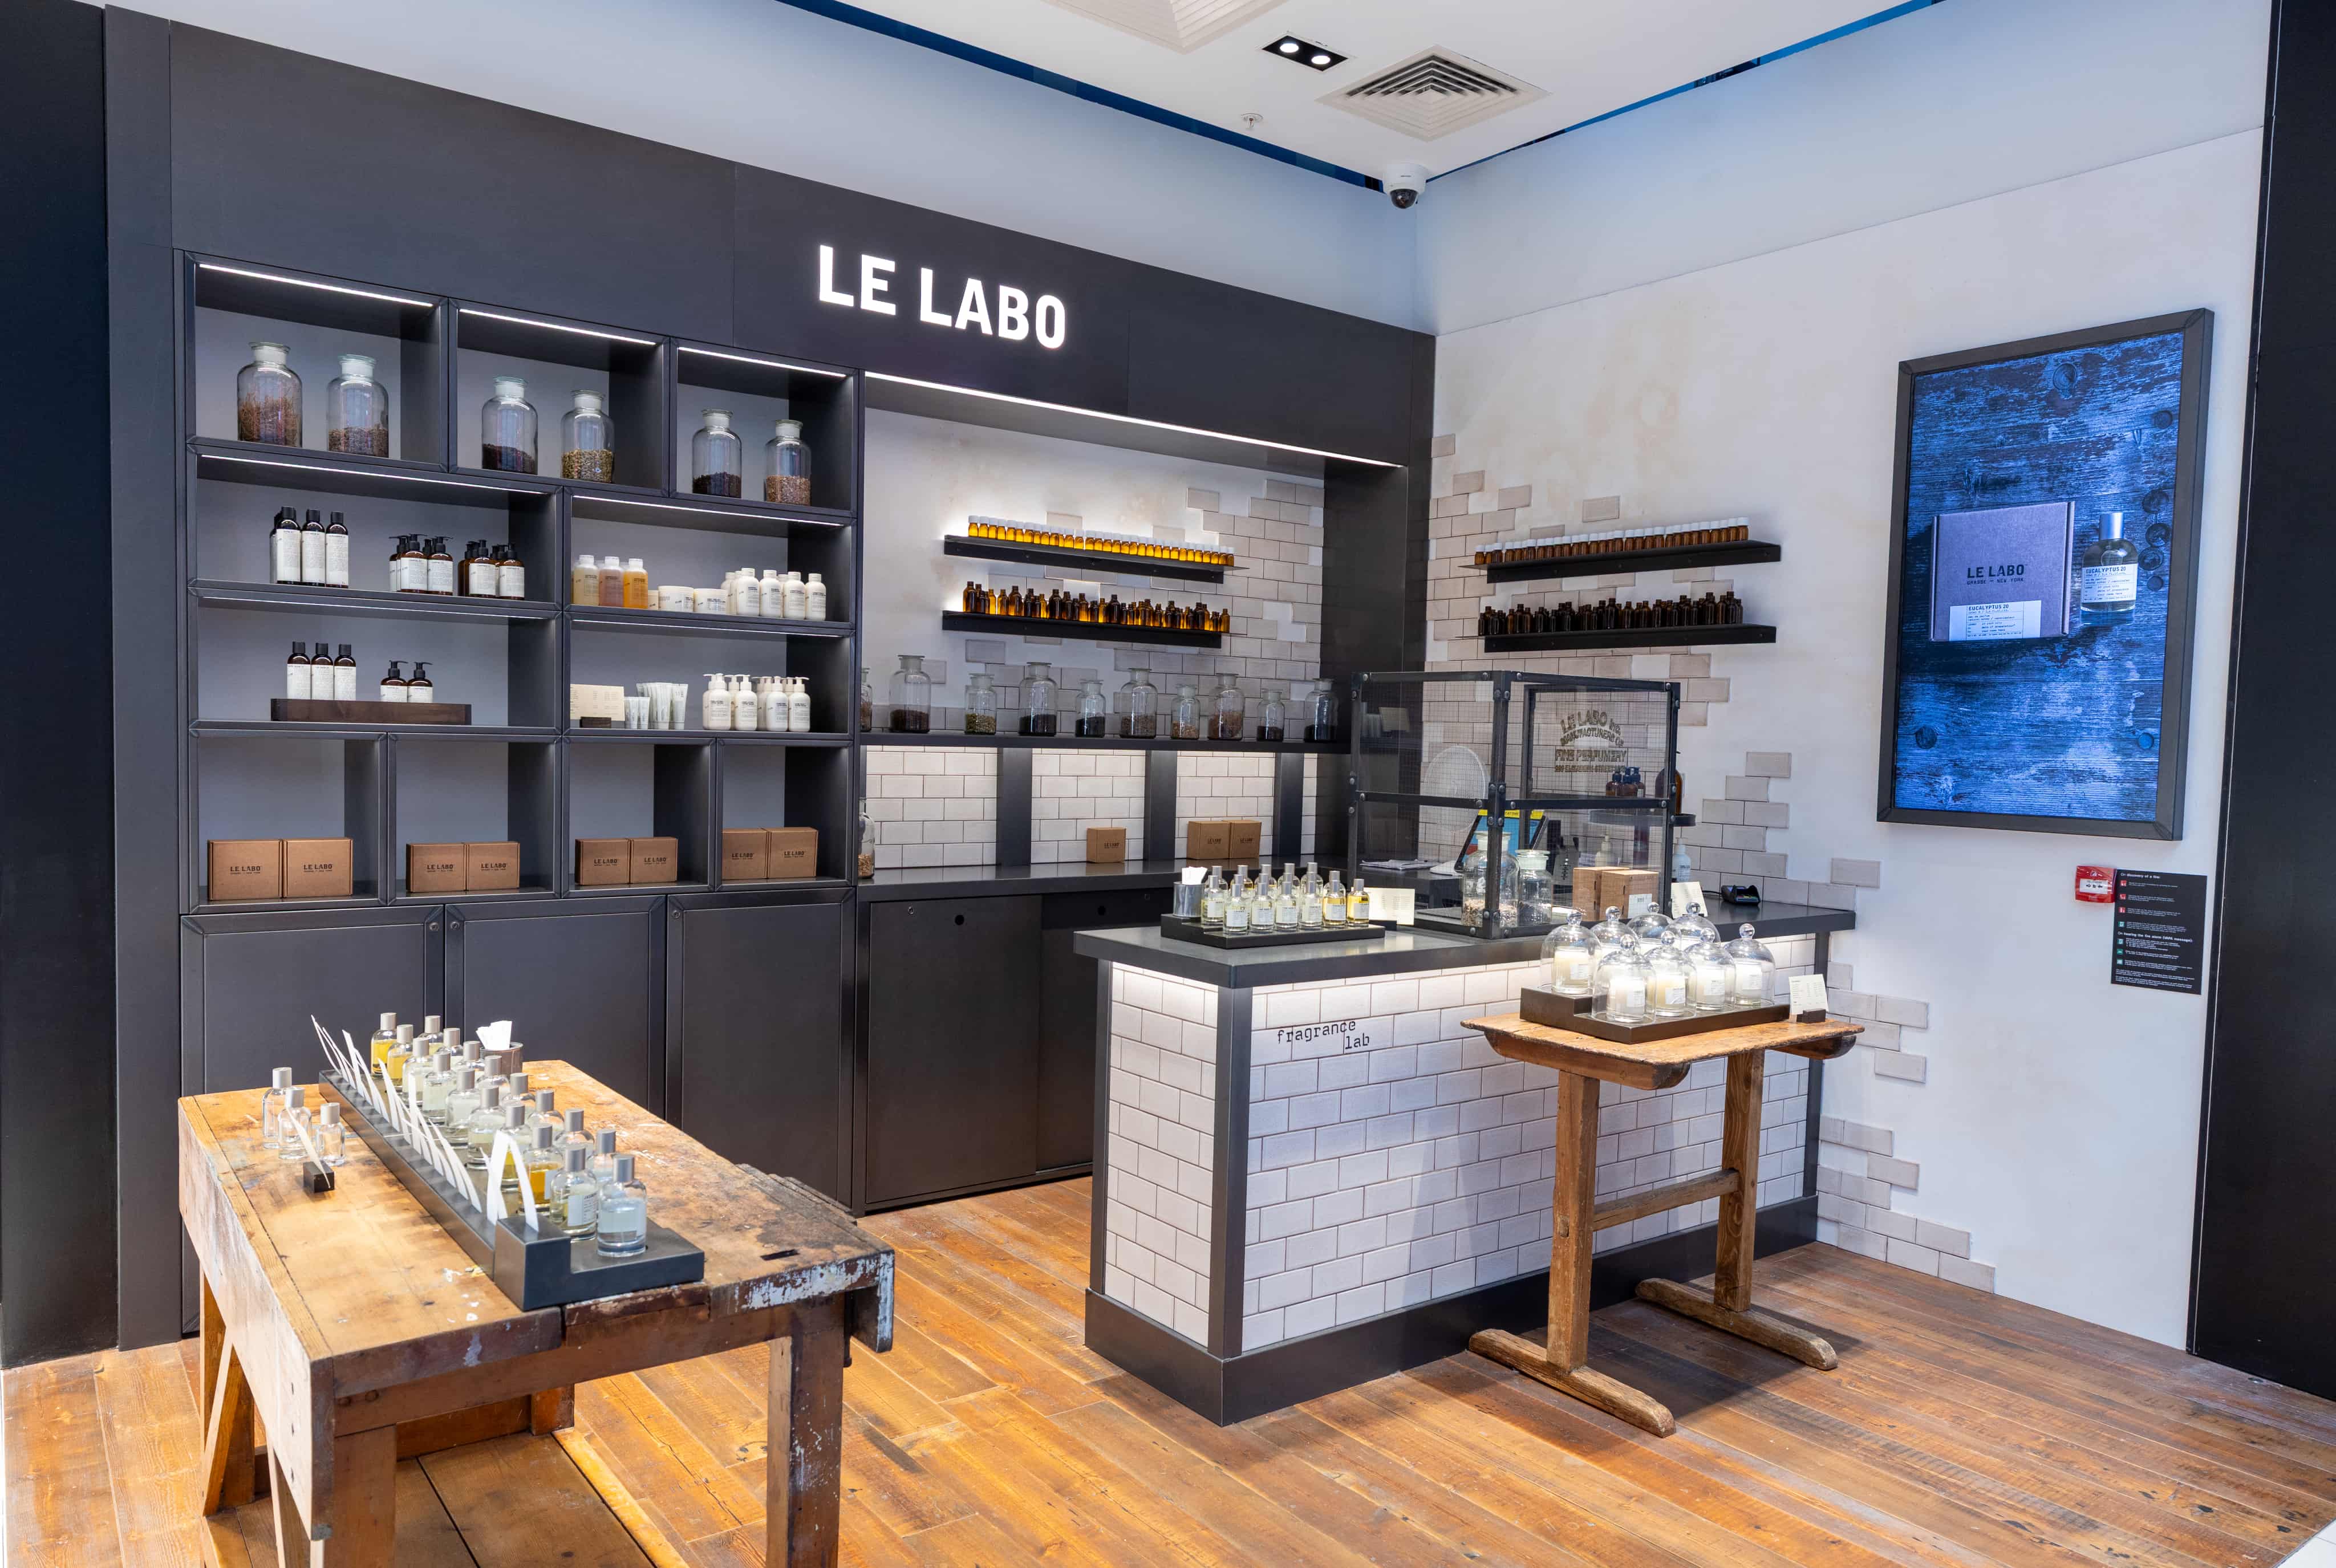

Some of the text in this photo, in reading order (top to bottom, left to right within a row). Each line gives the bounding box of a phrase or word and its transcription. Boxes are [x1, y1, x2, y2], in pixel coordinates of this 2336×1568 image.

[819, 245, 1065, 349] LE LABO
[1967, 564, 2025, 578] LE LABO
[1560, 713, 1576, 734] LE
[1577, 710, 1608, 727] LABO
[1560, 727, 1615, 746] MANUFACTURERS
[1555, 749, 1627, 762] FINE PERFUMERY
[1277, 1021, 1356, 1044] fragrance
[1345, 1033, 1370, 1050] lab
